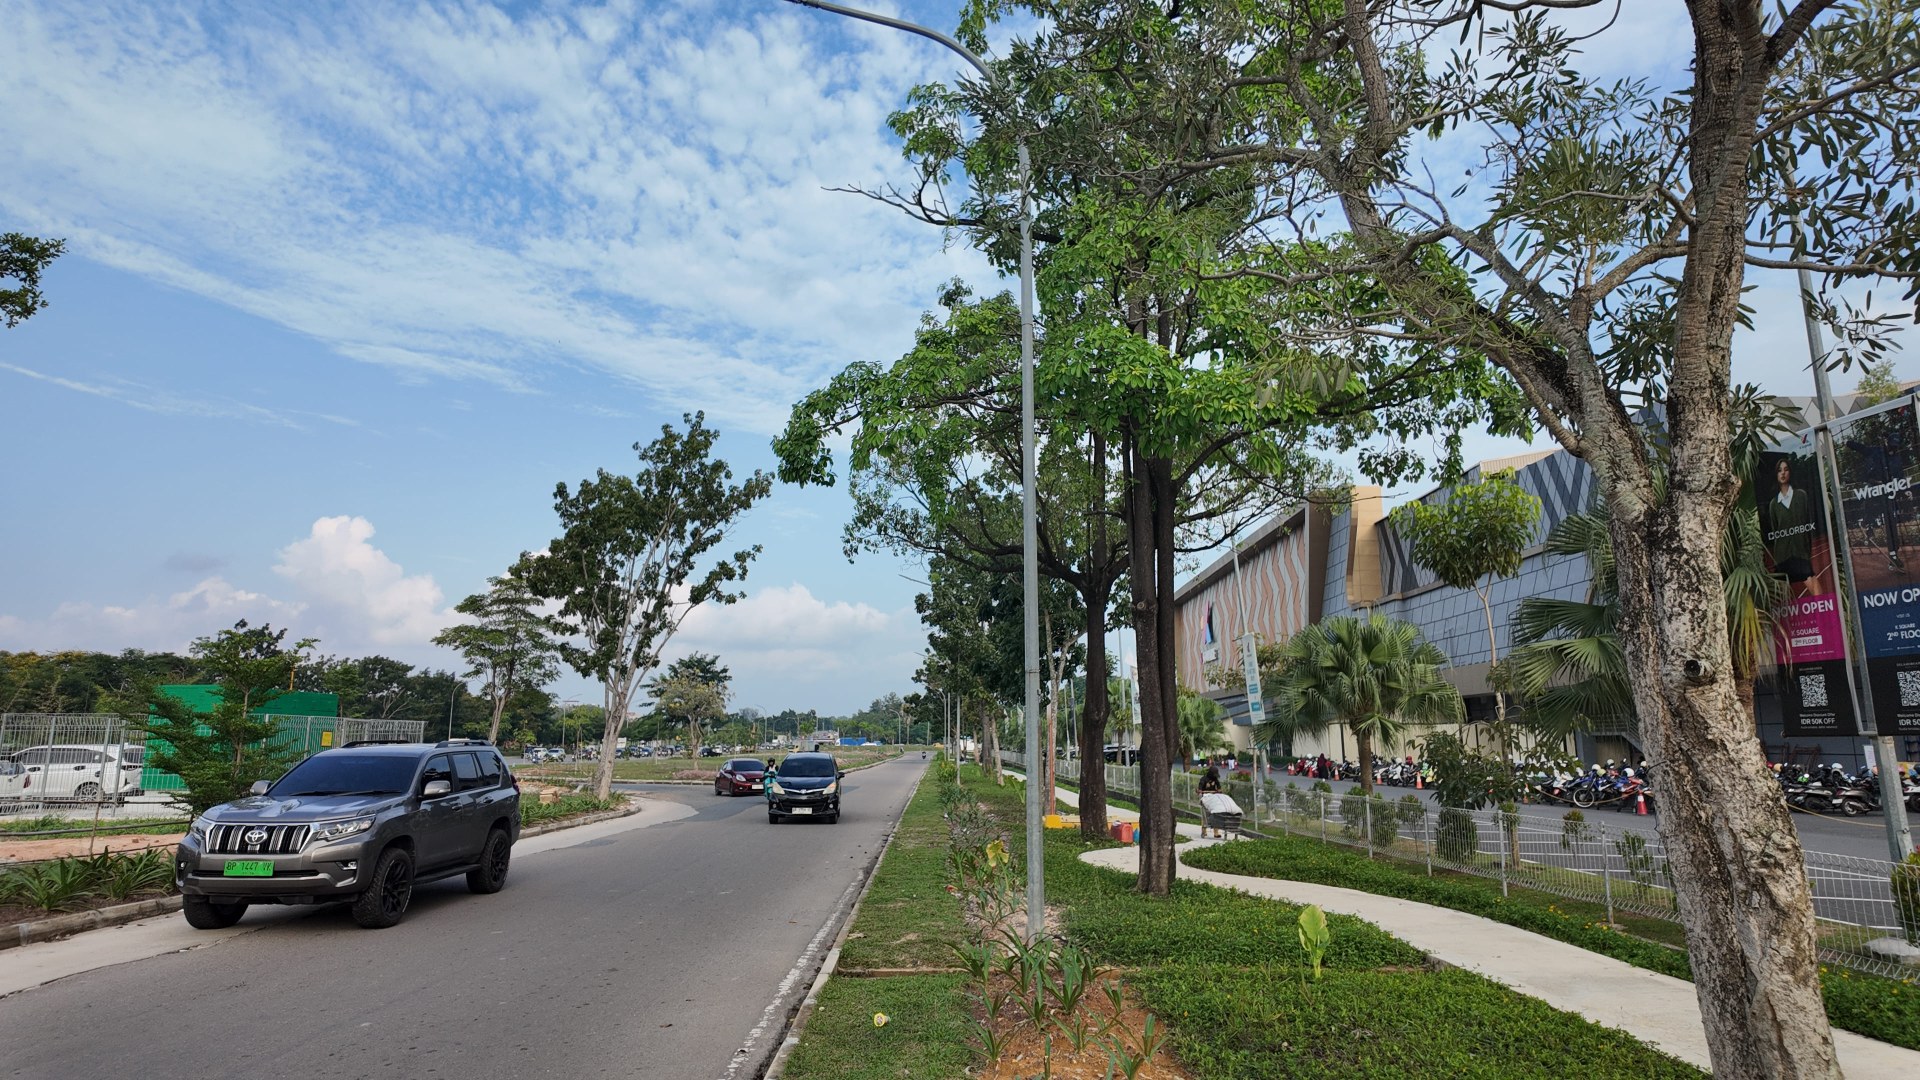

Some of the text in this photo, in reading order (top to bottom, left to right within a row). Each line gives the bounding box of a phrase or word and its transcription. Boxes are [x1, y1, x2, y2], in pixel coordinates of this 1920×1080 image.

[1853, 476, 1912, 500] Wrangler
[1774, 522, 1816, 539] COLORBOX
[1802, 599, 1834, 615] OPEN
[1863, 591, 1898, 609] NOW
[1796, 627, 1820, 636] SQUARE
[1823, 717, 1836, 725] OFF
[241, 861, 259, 871] 1447
